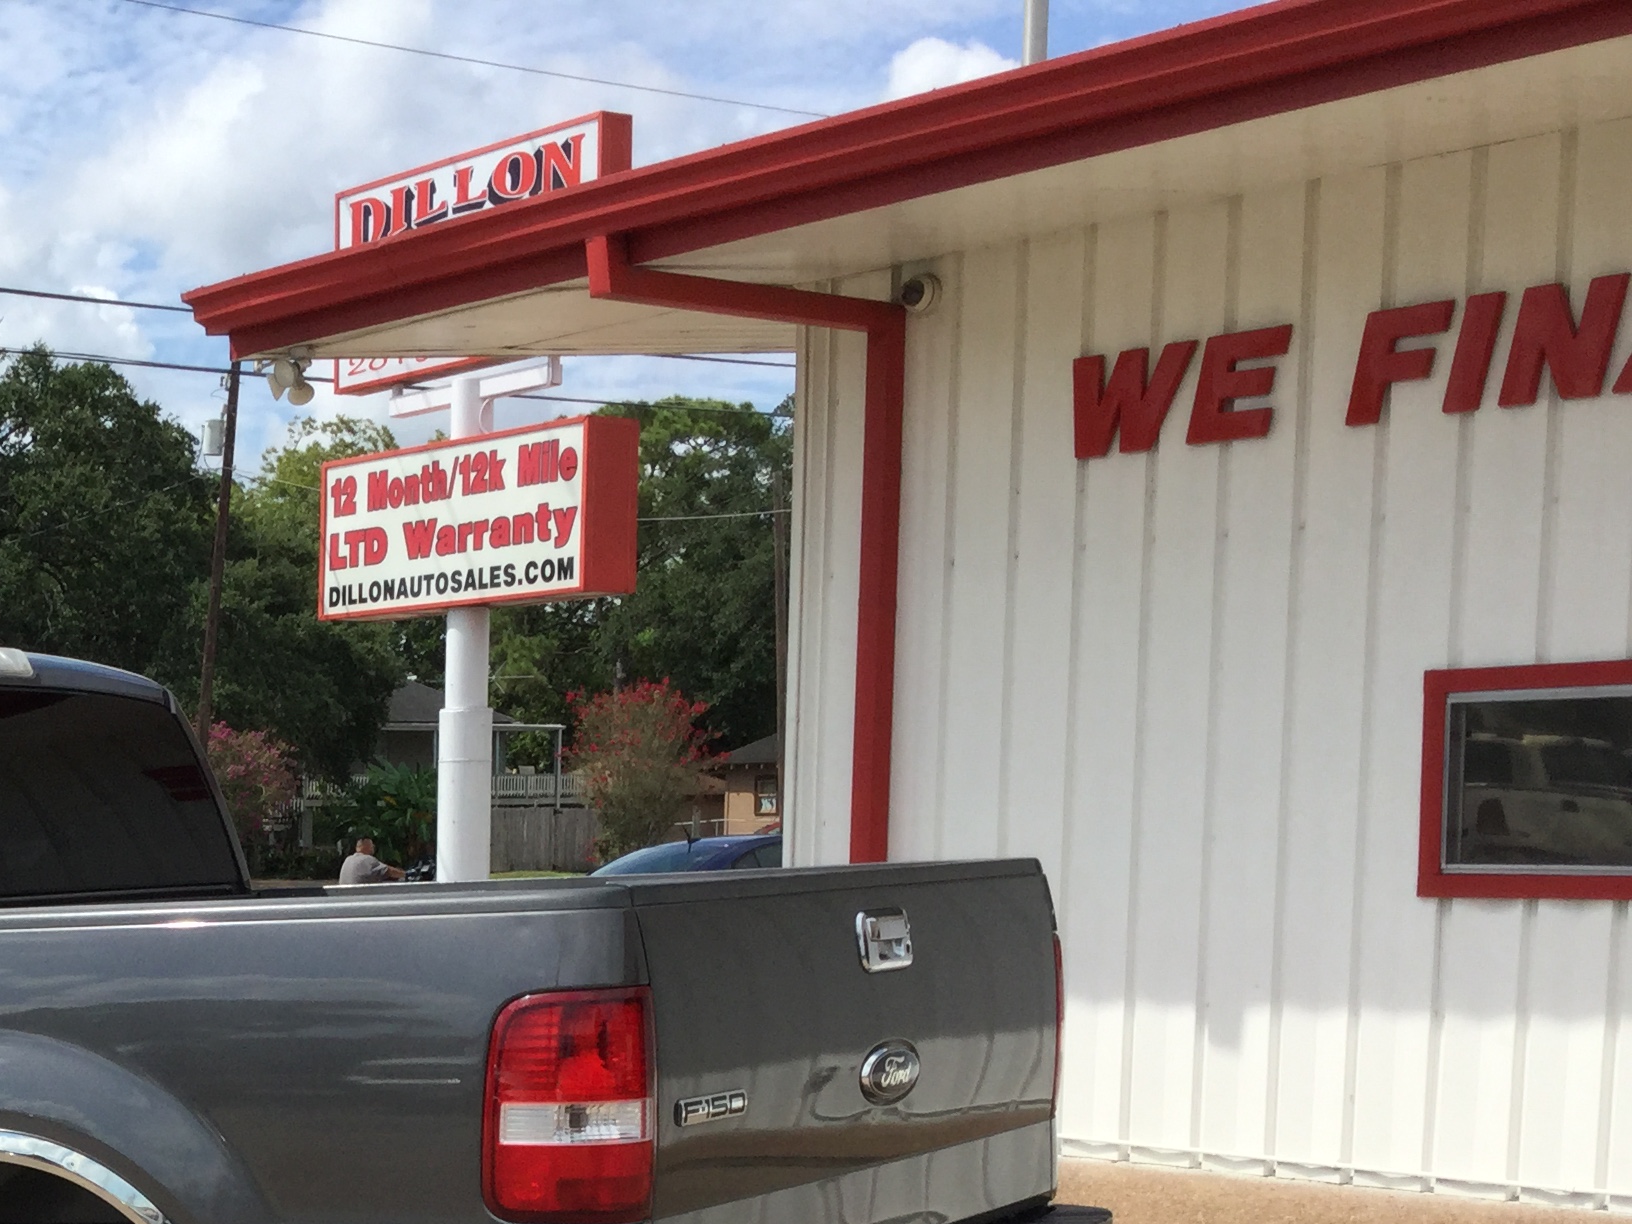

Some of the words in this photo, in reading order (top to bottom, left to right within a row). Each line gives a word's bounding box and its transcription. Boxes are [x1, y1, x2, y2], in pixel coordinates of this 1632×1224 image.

[349, 132, 587, 243] DILLON
[1072, 324, 1294, 460] WE
[1344, 272, 1632, 428] FIN
[330, 475, 358, 519] 12
[367, 449, 506, 514] Month/12k
[517, 438, 579, 487] Mile
[328, 526, 388, 572] LTD
[402, 501, 579, 561] Warranty
[328, 556, 575, 608] DILLONAUTOSALES.COM
[880, 1055, 913, 1088] Ford
